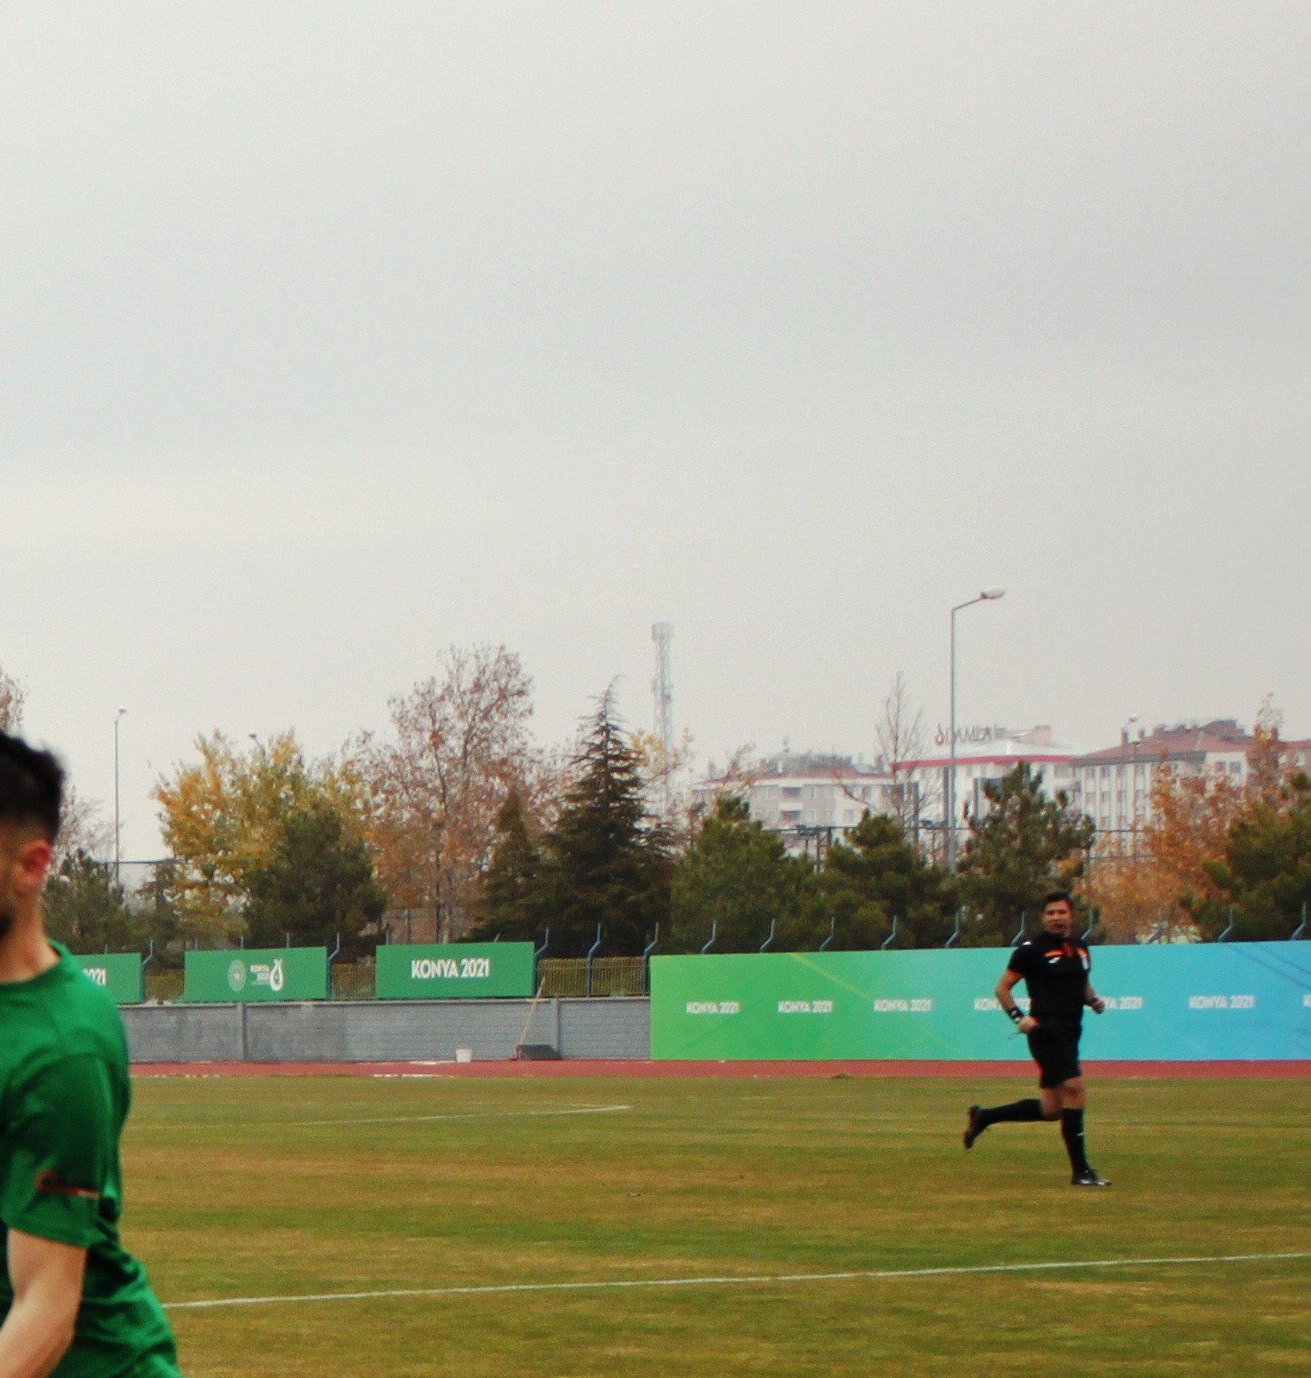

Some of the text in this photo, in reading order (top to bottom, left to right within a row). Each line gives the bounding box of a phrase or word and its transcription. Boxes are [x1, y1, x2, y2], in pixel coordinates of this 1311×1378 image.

[411, 958, 490, 978] KONYA 2021
[686, 1002, 739, 1013] KONYA 2021
[779, 1000, 833, 1013] KONYA 2021
[874, 999, 932, 1011] KONYA 2021
[974, 998, 1004, 1010] KON
[1119, 997, 1143, 1009] 2021
[1189, 996, 1255, 1009] KONYA 2021
